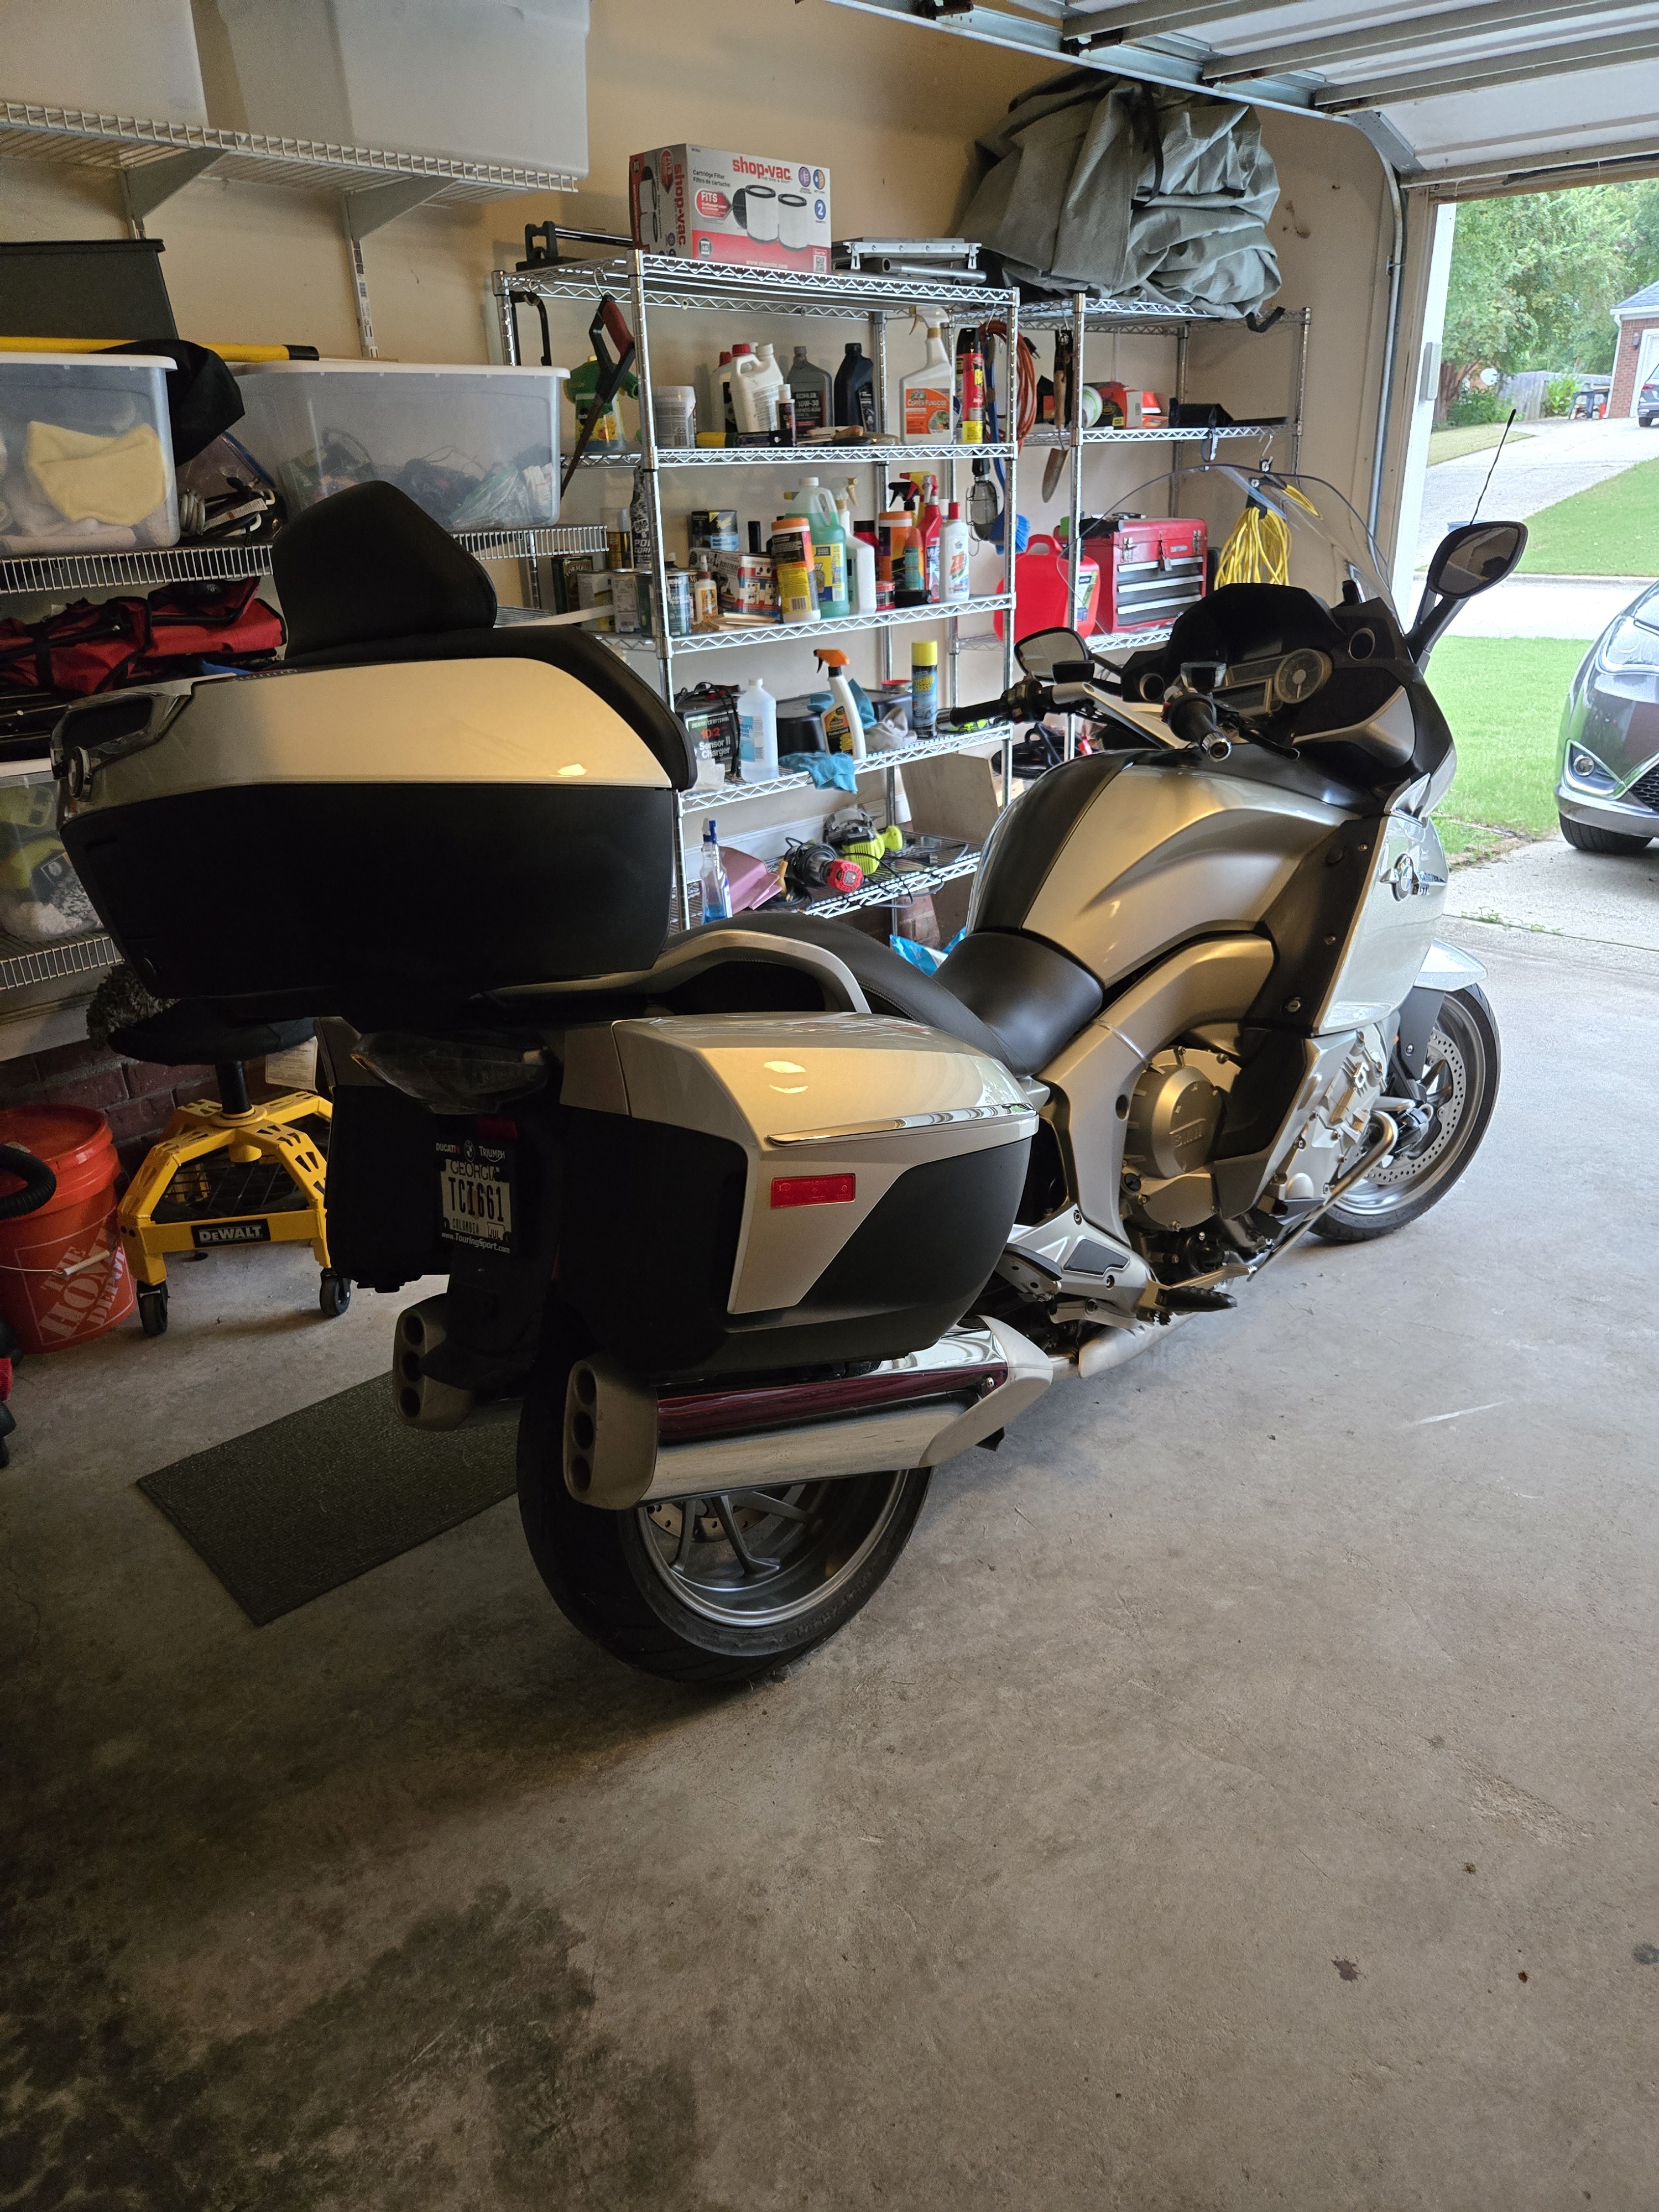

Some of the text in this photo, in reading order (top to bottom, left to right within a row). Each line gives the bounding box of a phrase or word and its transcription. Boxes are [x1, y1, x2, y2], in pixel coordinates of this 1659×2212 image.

[692, 169, 713, 178] Cartridge
[701, 191, 718, 203] FITS
[817, 202, 823, 216] 2
[699, 739, 725, 751] Sensor
[701, 747, 731, 759] Charger
[436, 1142, 456, 1154] DUCATI
[479, 1146, 505, 1160] TRIUMPH
[452, 1218, 479, 1234] COLUMBIA
[441, 1232, 510, 1254] www.TouringSport.com
